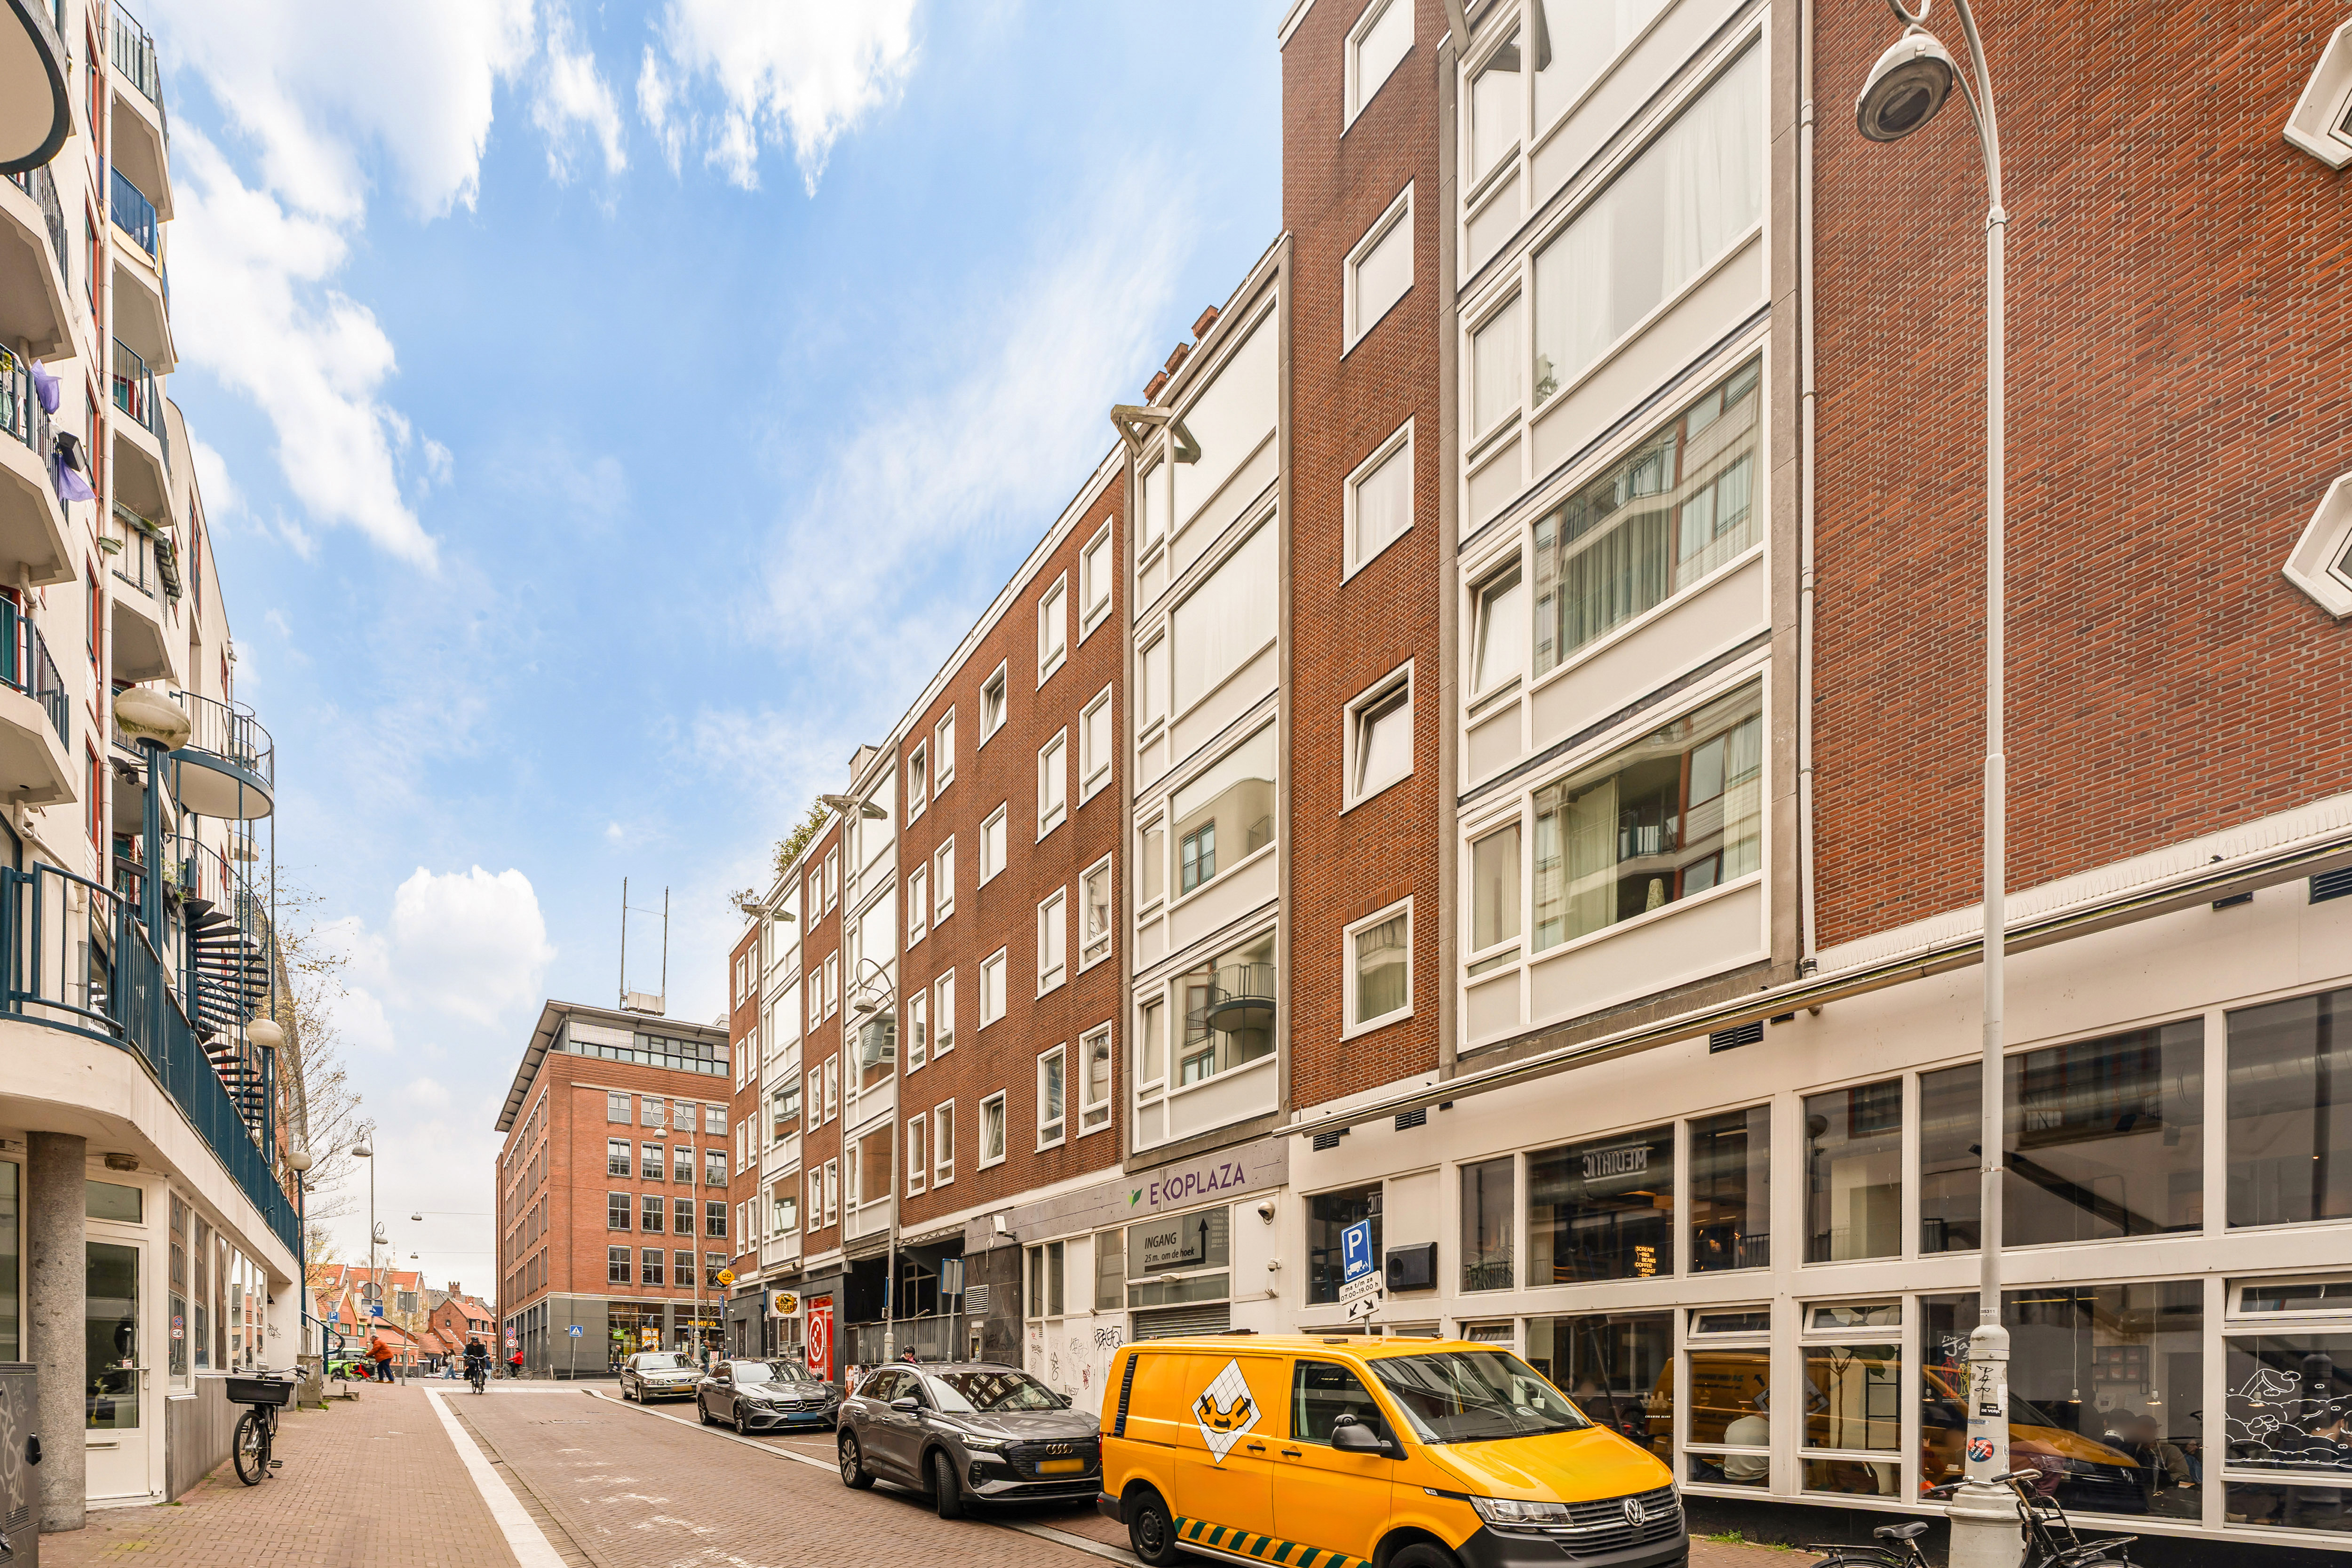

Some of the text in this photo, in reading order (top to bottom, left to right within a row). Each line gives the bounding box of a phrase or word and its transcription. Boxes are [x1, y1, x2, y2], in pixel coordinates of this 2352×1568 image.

[1151, 1162, 1245, 1205] EKOPLAZA
[1144, 1232, 1176, 1249] INGANG
[1348, 1228, 1363, 1258] P
[1144, 1254, 1152, 1263] 25
[1172, 1250, 1179, 1258] de
[1180, 1247, 1194, 1257] hoek
[1354, 1280, 1365, 1289] t/m
[1341, 1285, 1374, 1302] 07.00-19.00
[1972, 1441, 1988, 1459] SCHULDEN
